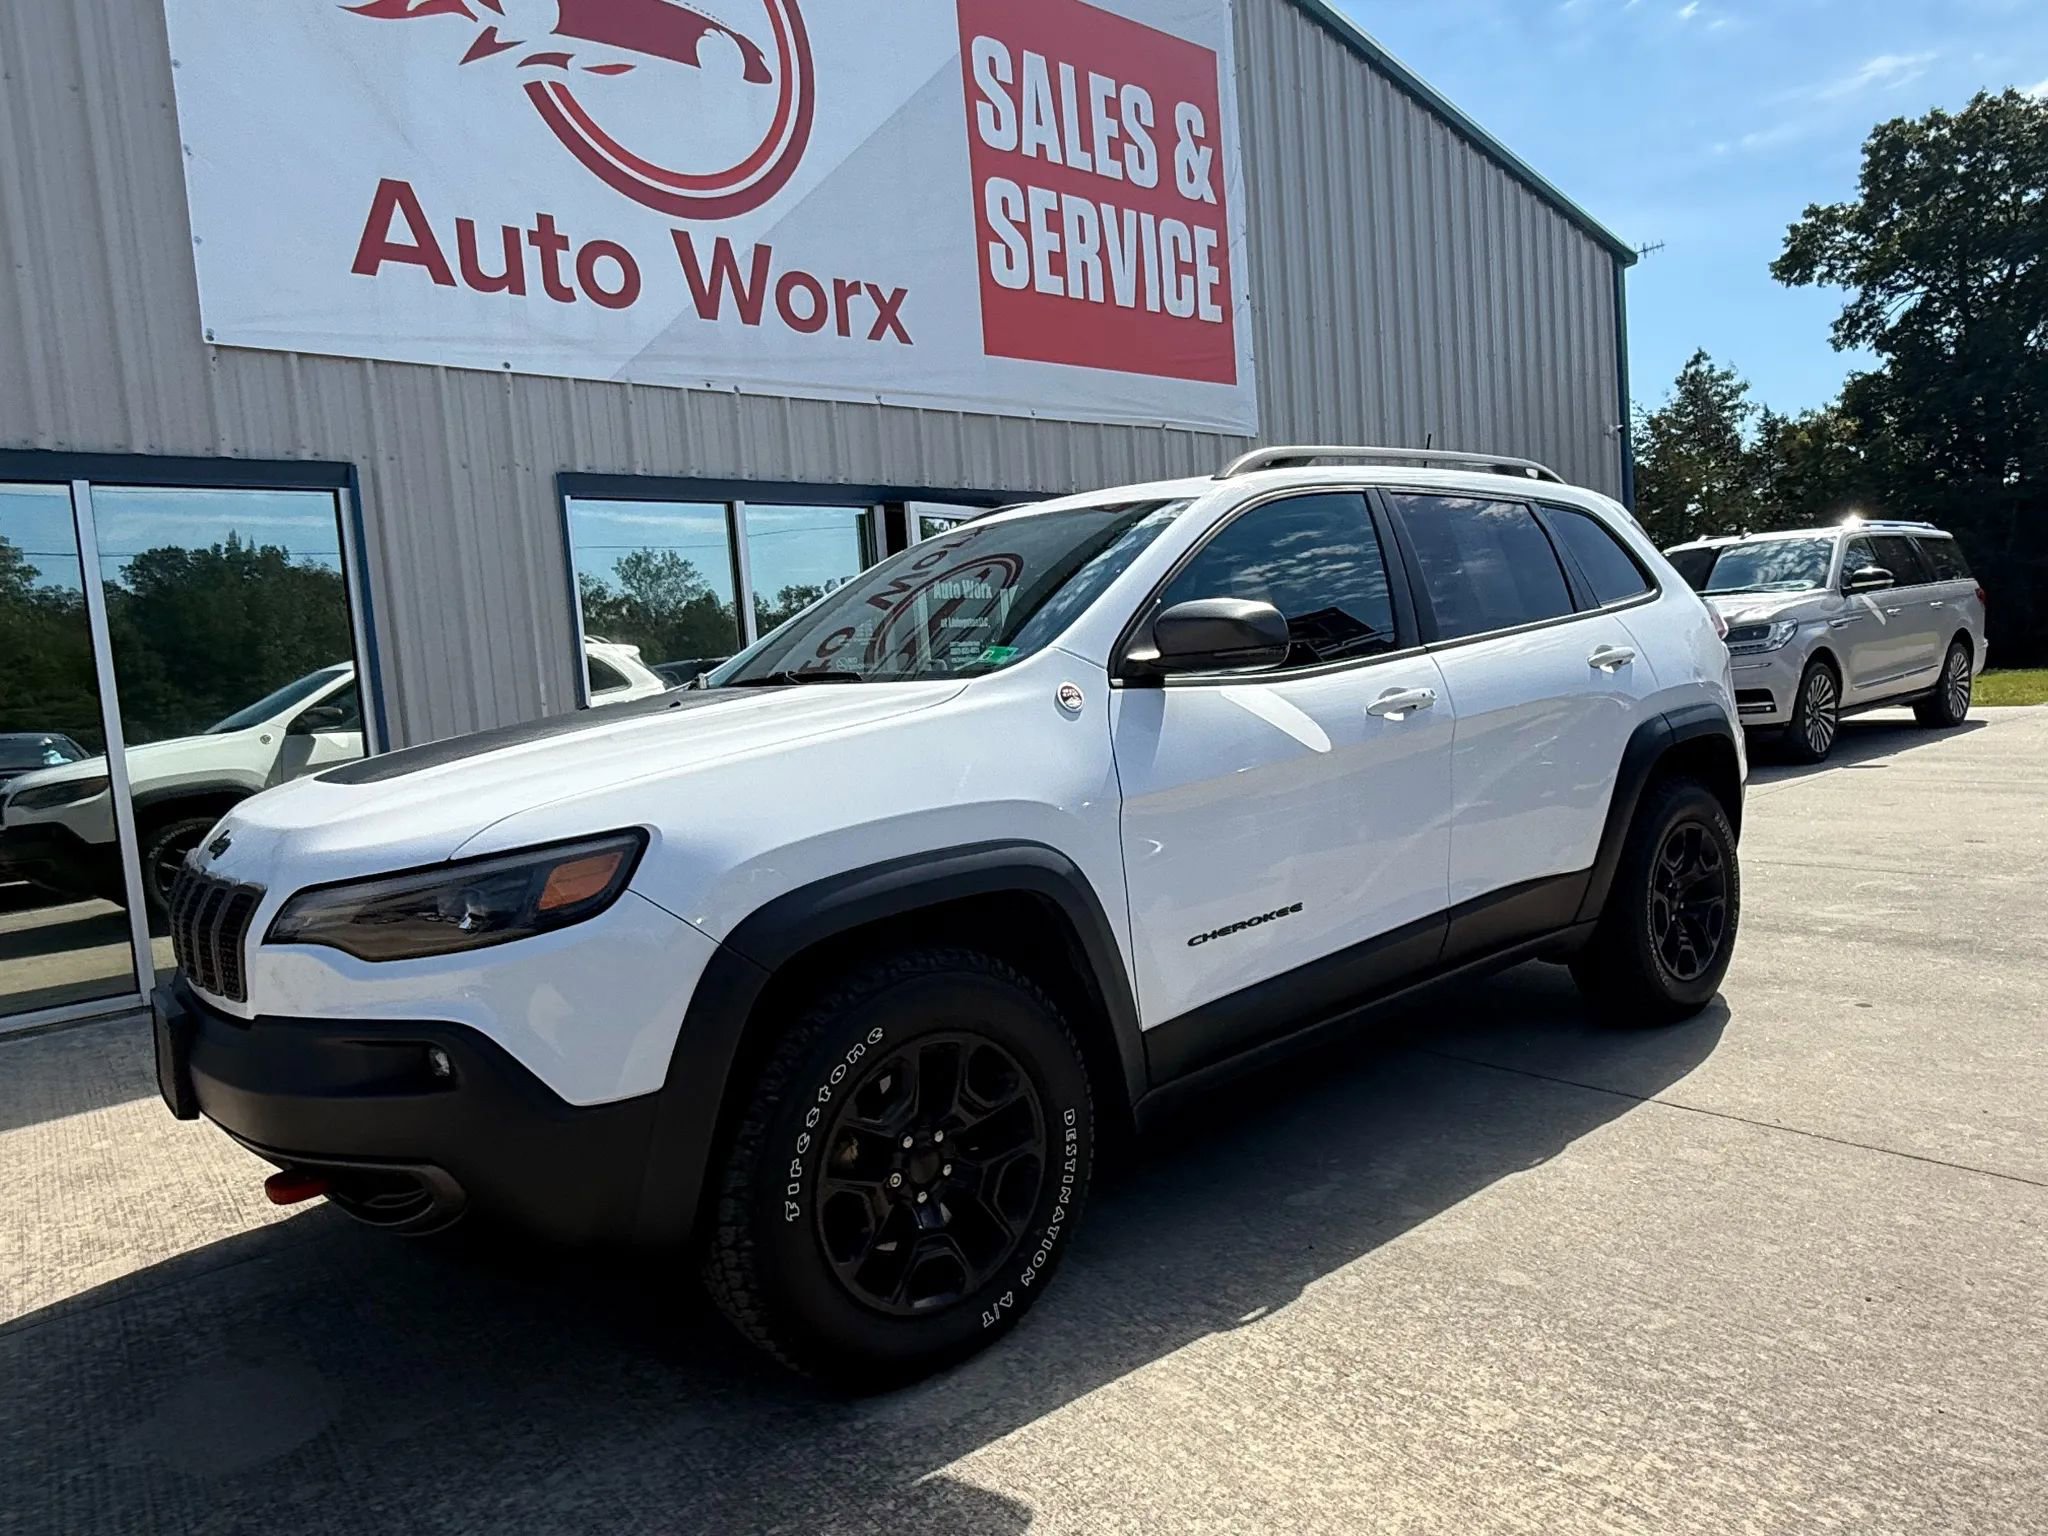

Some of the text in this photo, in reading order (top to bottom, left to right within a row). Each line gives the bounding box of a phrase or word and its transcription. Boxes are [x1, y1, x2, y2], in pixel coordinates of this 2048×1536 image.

[971, 35, 1217, 205] SALES &
[350, 178, 914, 346] Auto Worx
[984, 176, 1224, 324] SERVICE
[933, 581, 961, 600] Auto
[1187, 901, 1304, 947] CHEROKEE
[982, 1108, 1077, 1328] DESTINATION A/T
